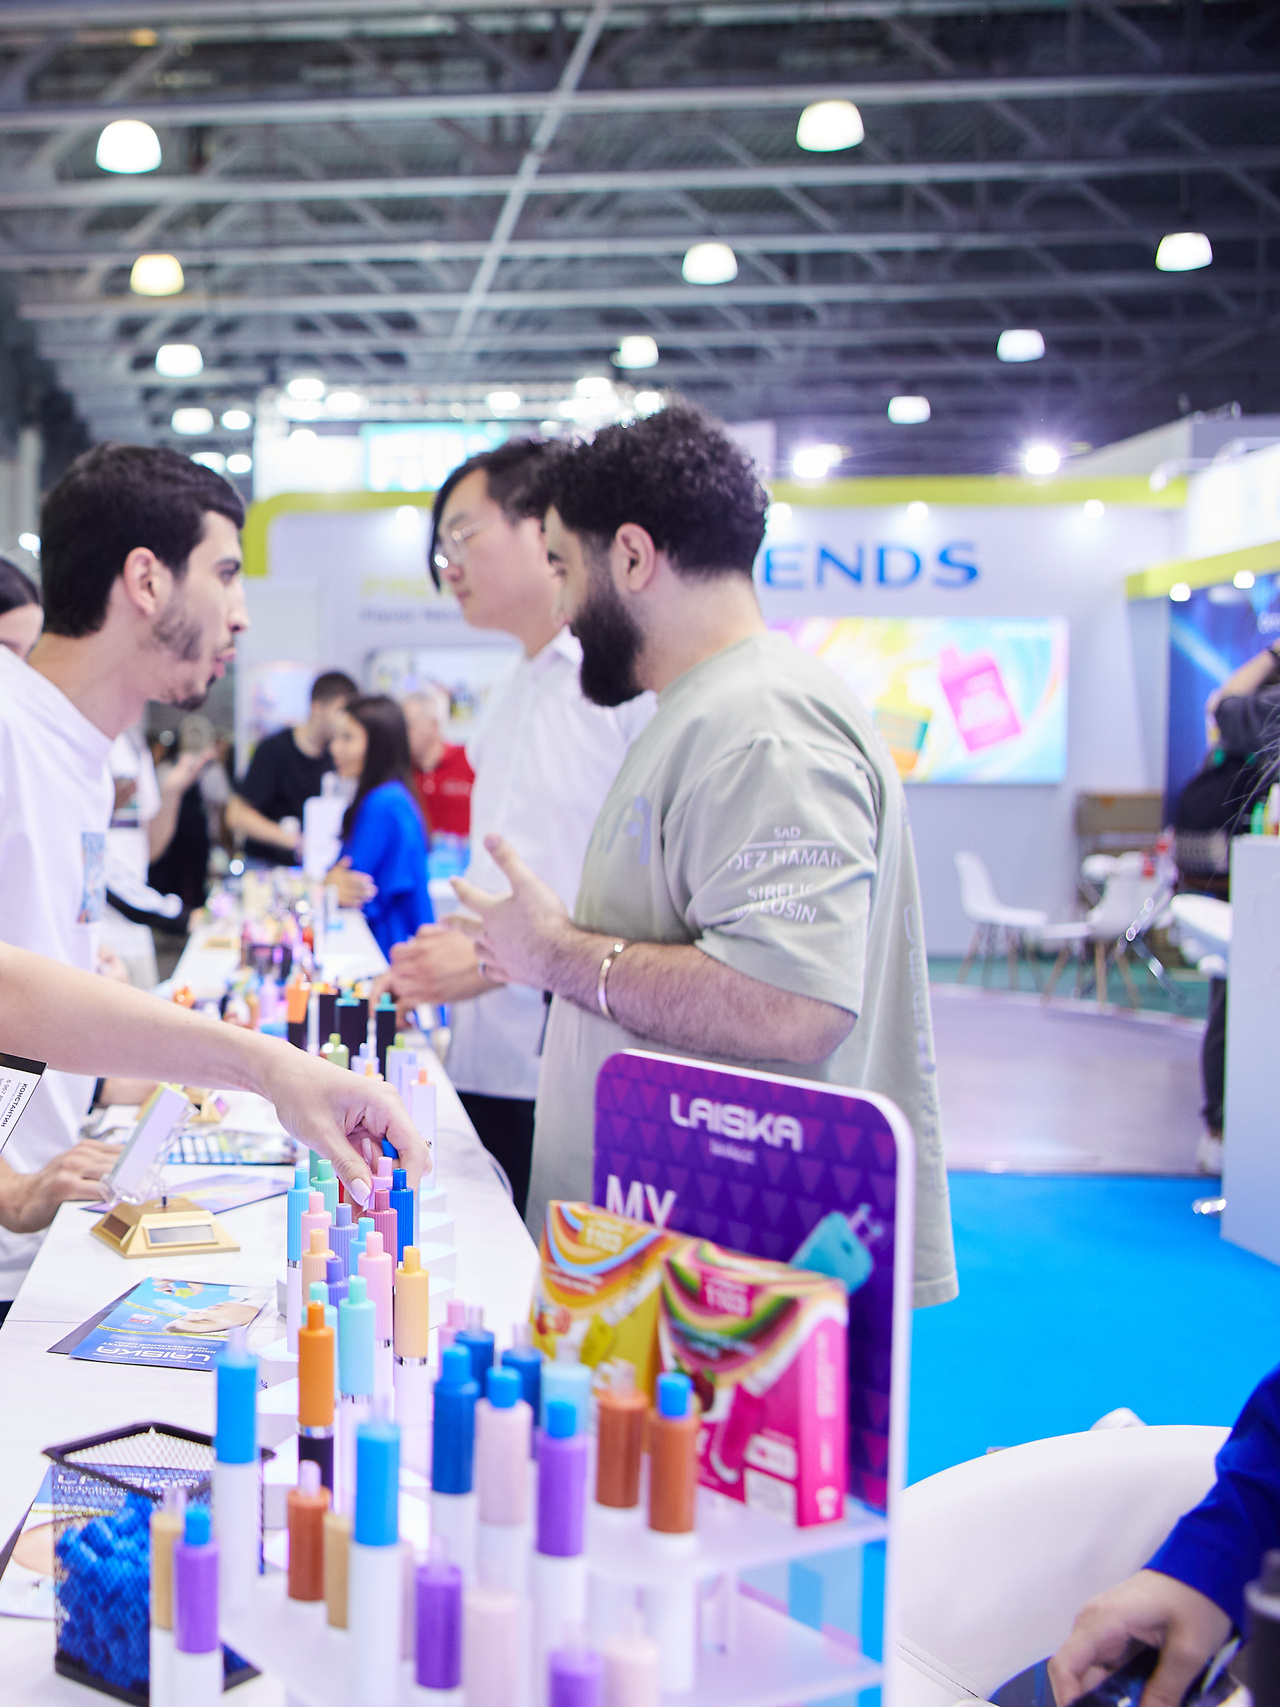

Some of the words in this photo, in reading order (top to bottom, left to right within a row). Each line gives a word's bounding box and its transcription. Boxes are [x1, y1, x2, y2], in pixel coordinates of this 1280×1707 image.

[774, 825, 801, 840] SAD
[0, 1082, 28, 1128] КОНСТАНТИН
[670, 1093, 805, 1152] LAISKA
[96, 1346, 211, 1361] LAISKA
